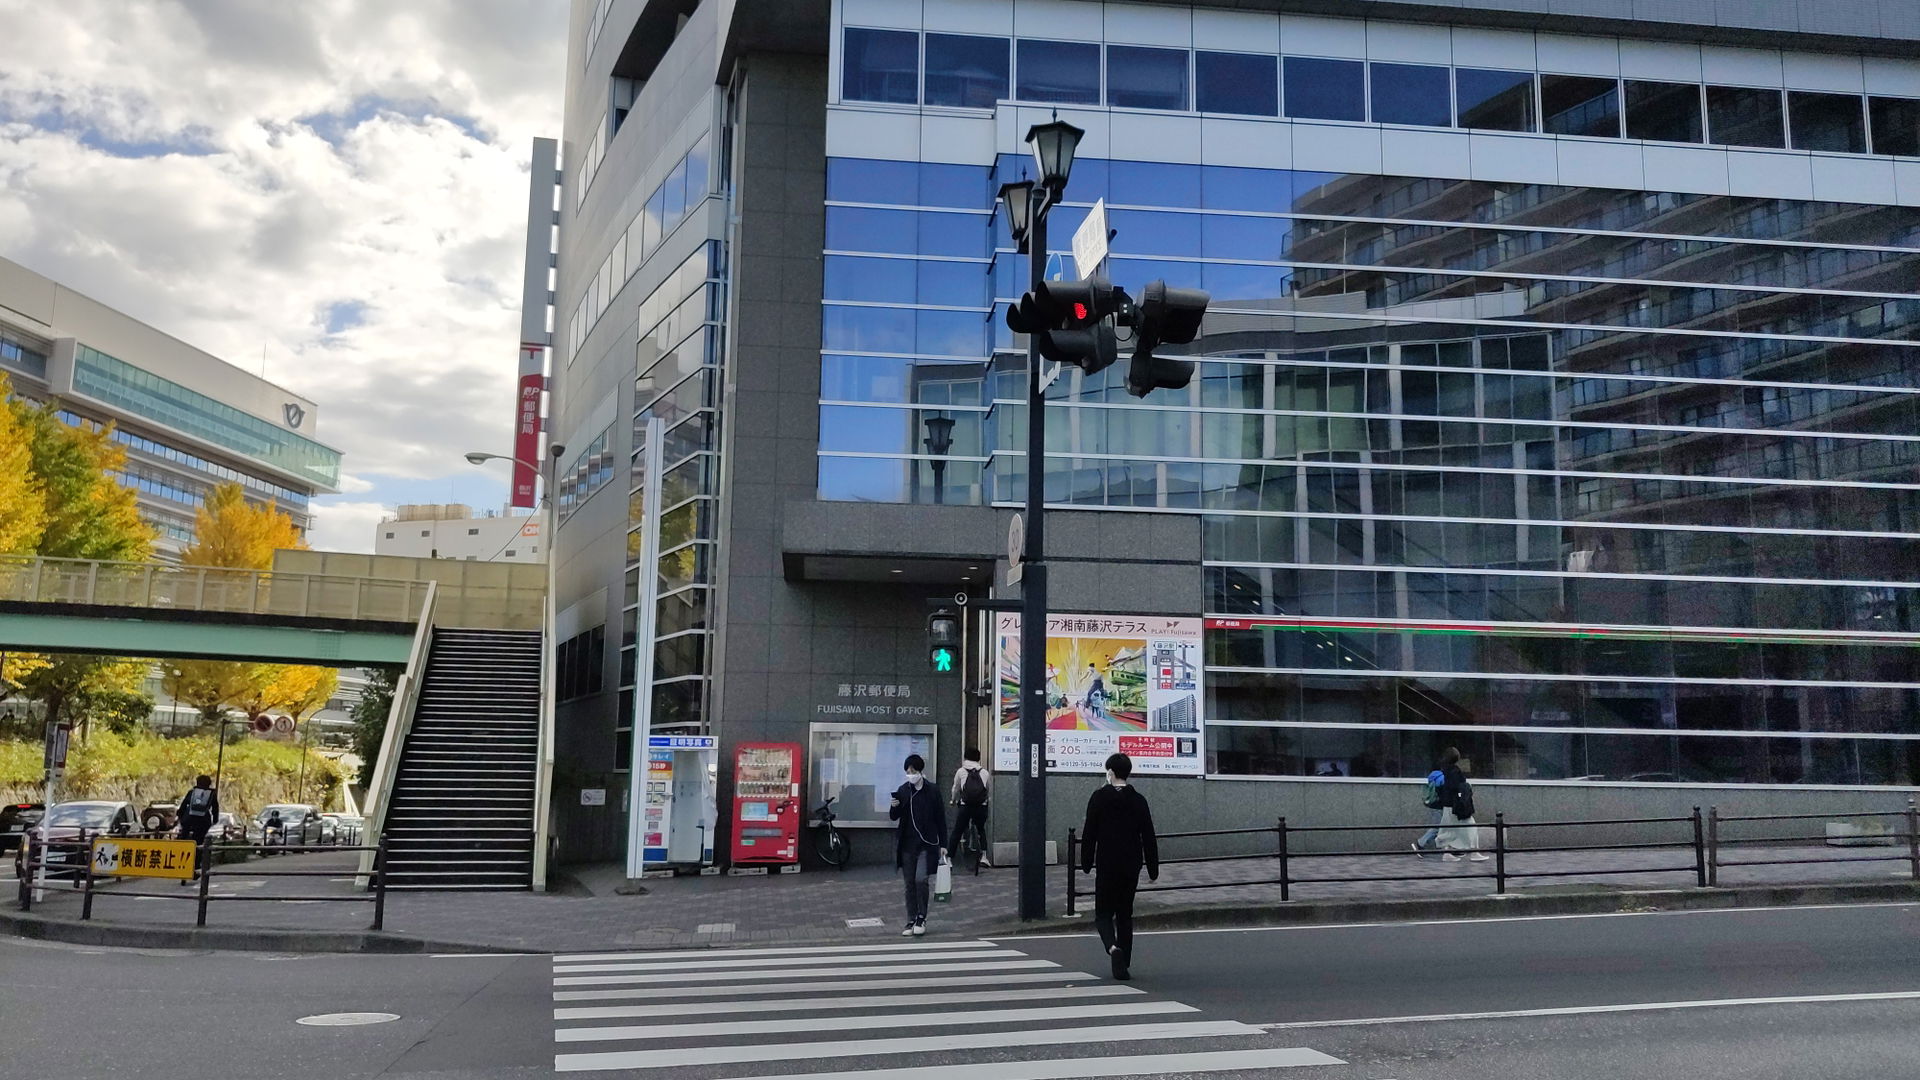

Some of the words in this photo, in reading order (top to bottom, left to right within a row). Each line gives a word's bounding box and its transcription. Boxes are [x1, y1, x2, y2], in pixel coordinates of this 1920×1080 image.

[523, 401, 536, 435] 郵便局
[1001, 616, 1148, 633] グレア湘南藤沢テラス
[838, 684, 911, 698] 藤沢郵便局
[817, 705, 862, 714] FUJISAWA
[866, 705, 892, 714] POST
[896, 706, 930, 715] OFFICE
[670, 738, 702, 747] 証明写真
[1060, 745, 1081, 755] 205
[121, 849, 191, 870] 横断禁止!!
